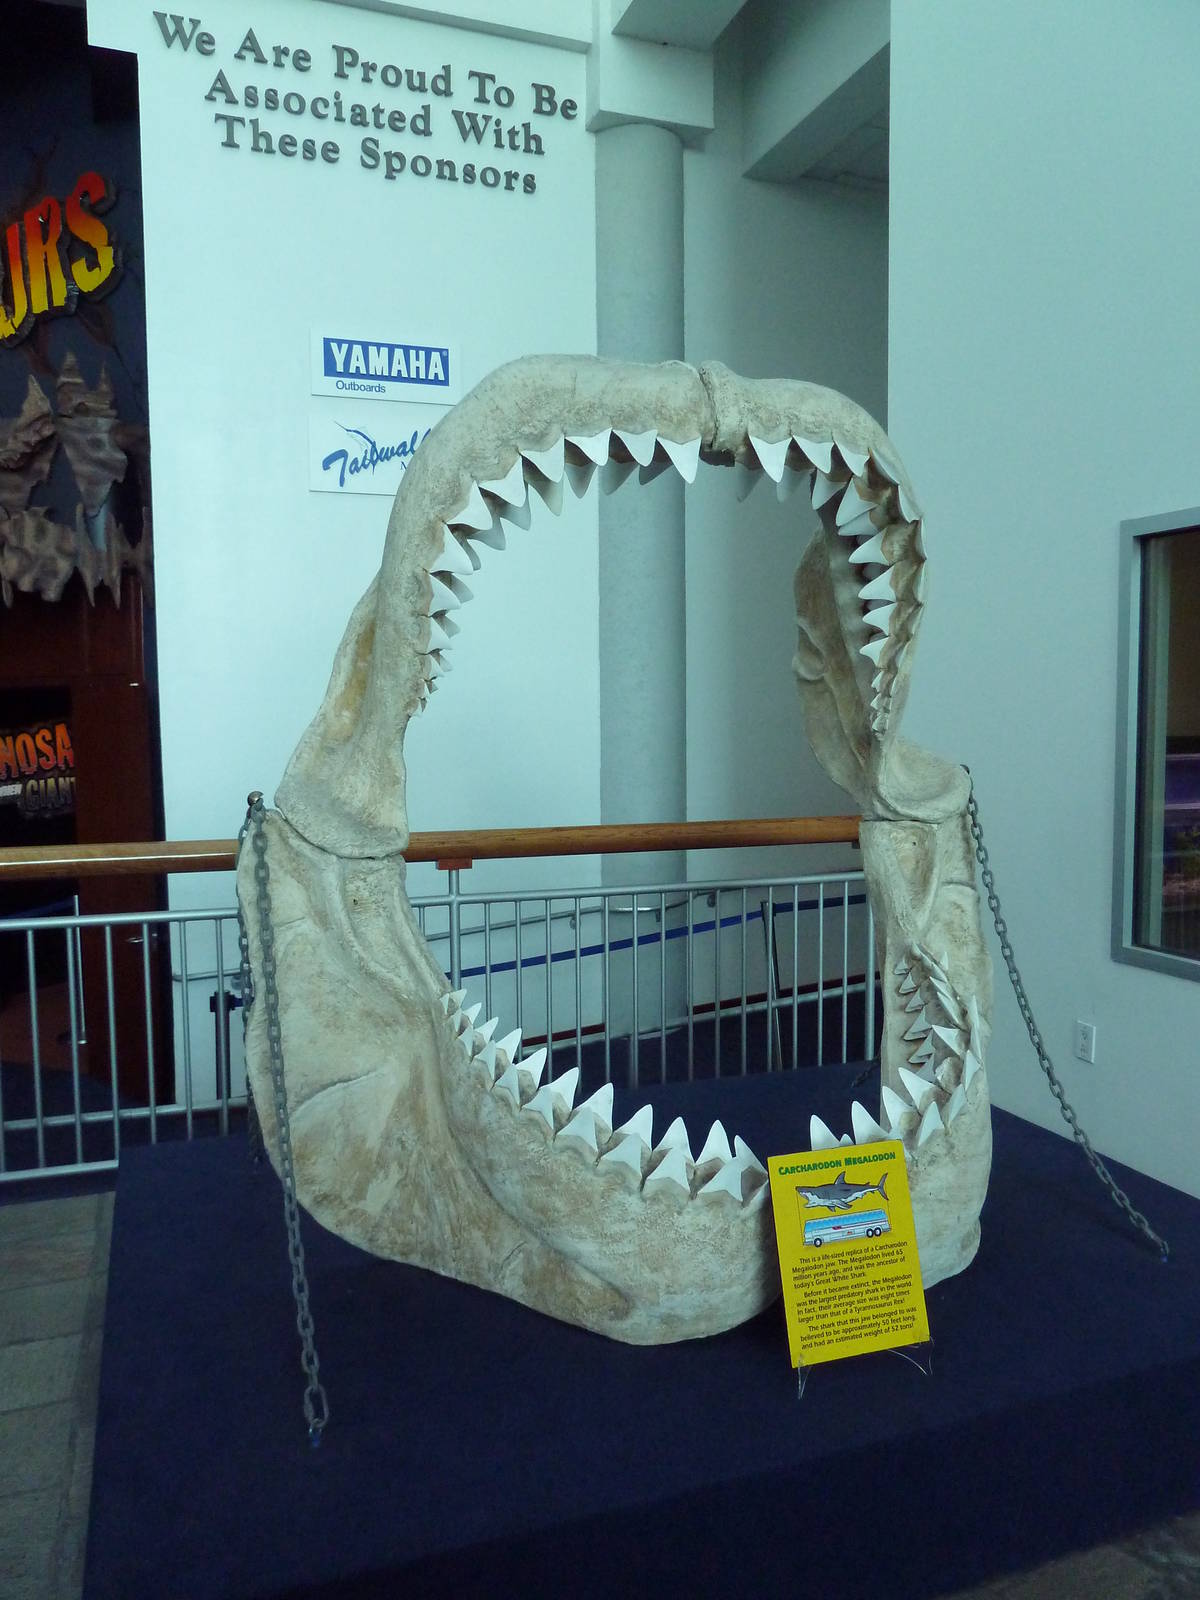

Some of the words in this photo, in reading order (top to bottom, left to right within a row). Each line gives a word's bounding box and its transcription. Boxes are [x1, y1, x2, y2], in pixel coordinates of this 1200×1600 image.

[153, 11, 216, 56] We
[234, 28, 312, 72] Are
[331, 45, 454, 98] Proud
[468, 70, 516, 108] To
[531, 83, 578, 120] Be
[204, 69, 433, 137] Associated
[451, 110, 546, 155] With
[214, 112, 340, 163] These
[359, 137, 537, 194] Sponsors
[330, 342, 445, 381] YAMAHA
[335, 380, 386, 393] Outboards
[322, 428, 432, 488] Tailwal
